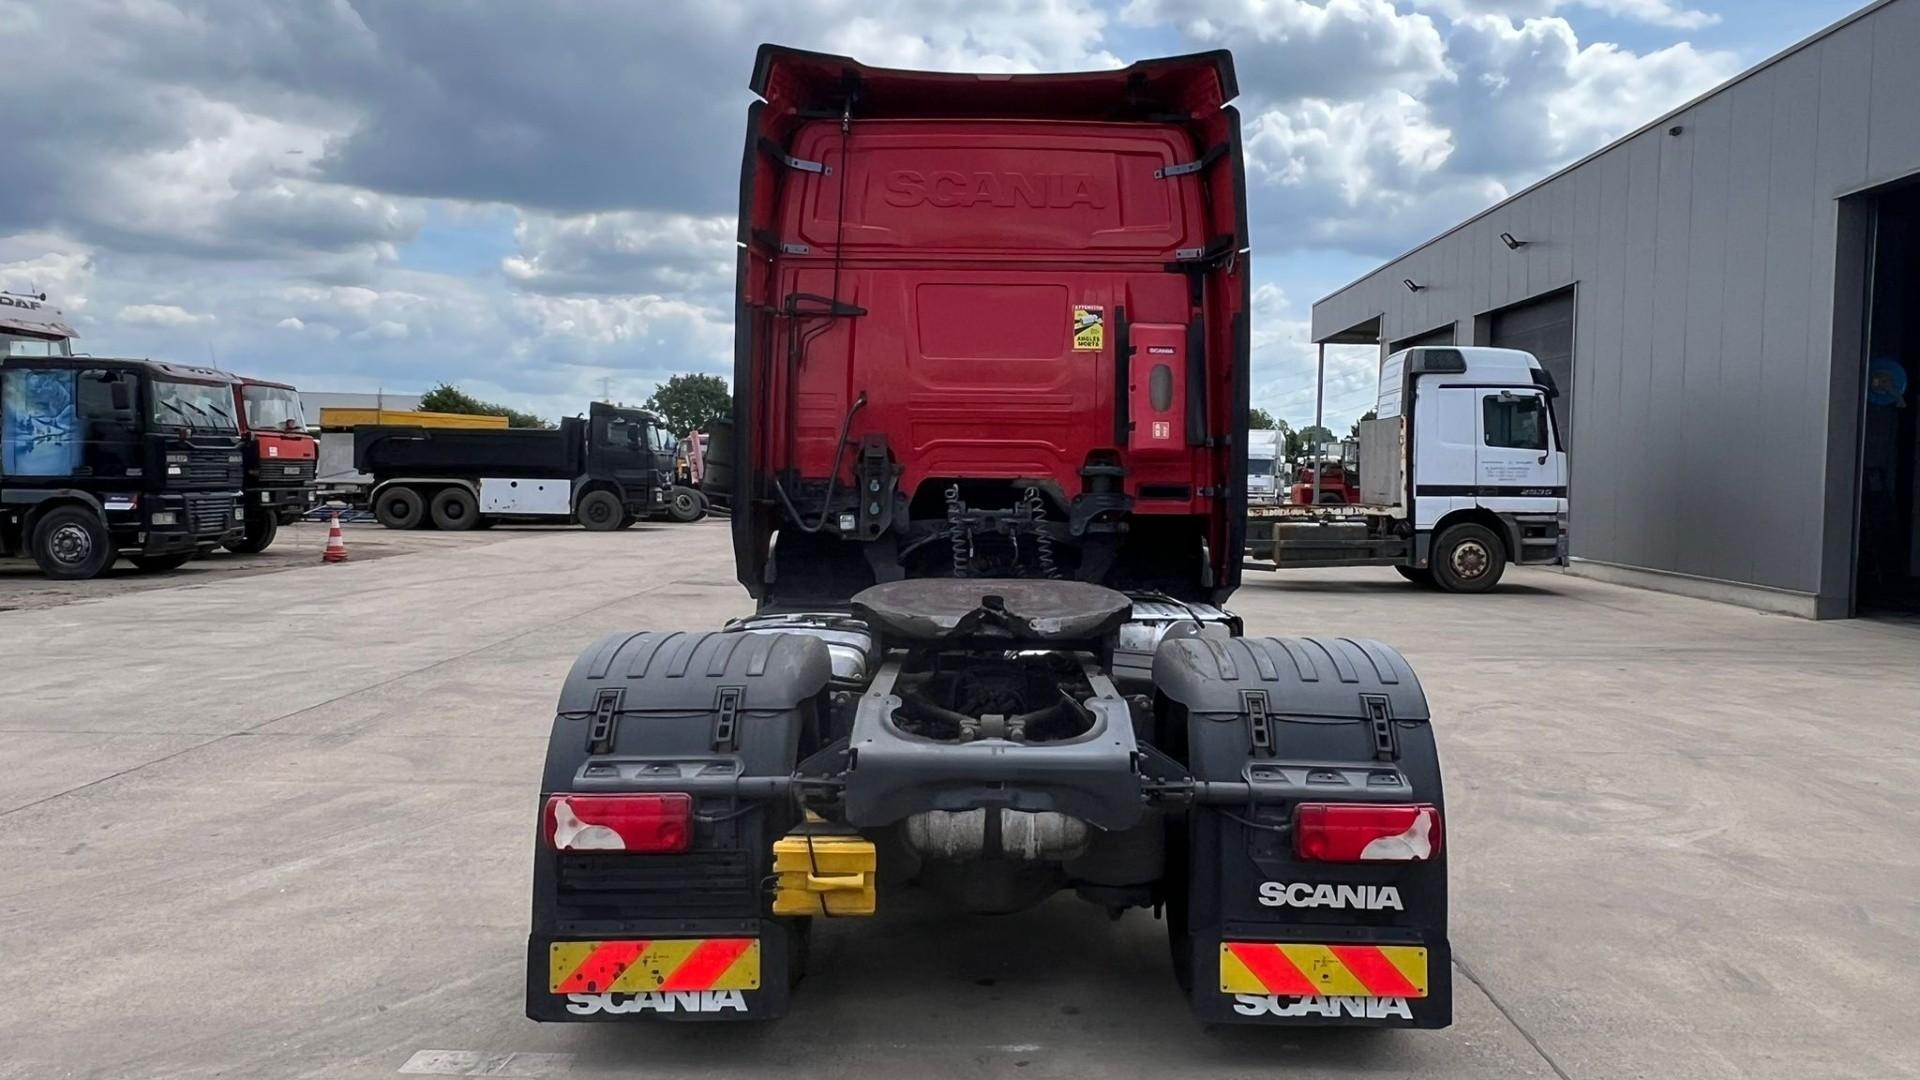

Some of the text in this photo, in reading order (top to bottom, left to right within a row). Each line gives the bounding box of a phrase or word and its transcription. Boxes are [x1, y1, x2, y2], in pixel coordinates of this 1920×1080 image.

[884, 171, 1105, 209] SCANIA
[0, 296, 41, 309] DAF
[1258, 881, 1404, 911] SCANIA
[566, 989, 748, 1015] SCANIA
[1232, 994, 1414, 1020] SCANIA
